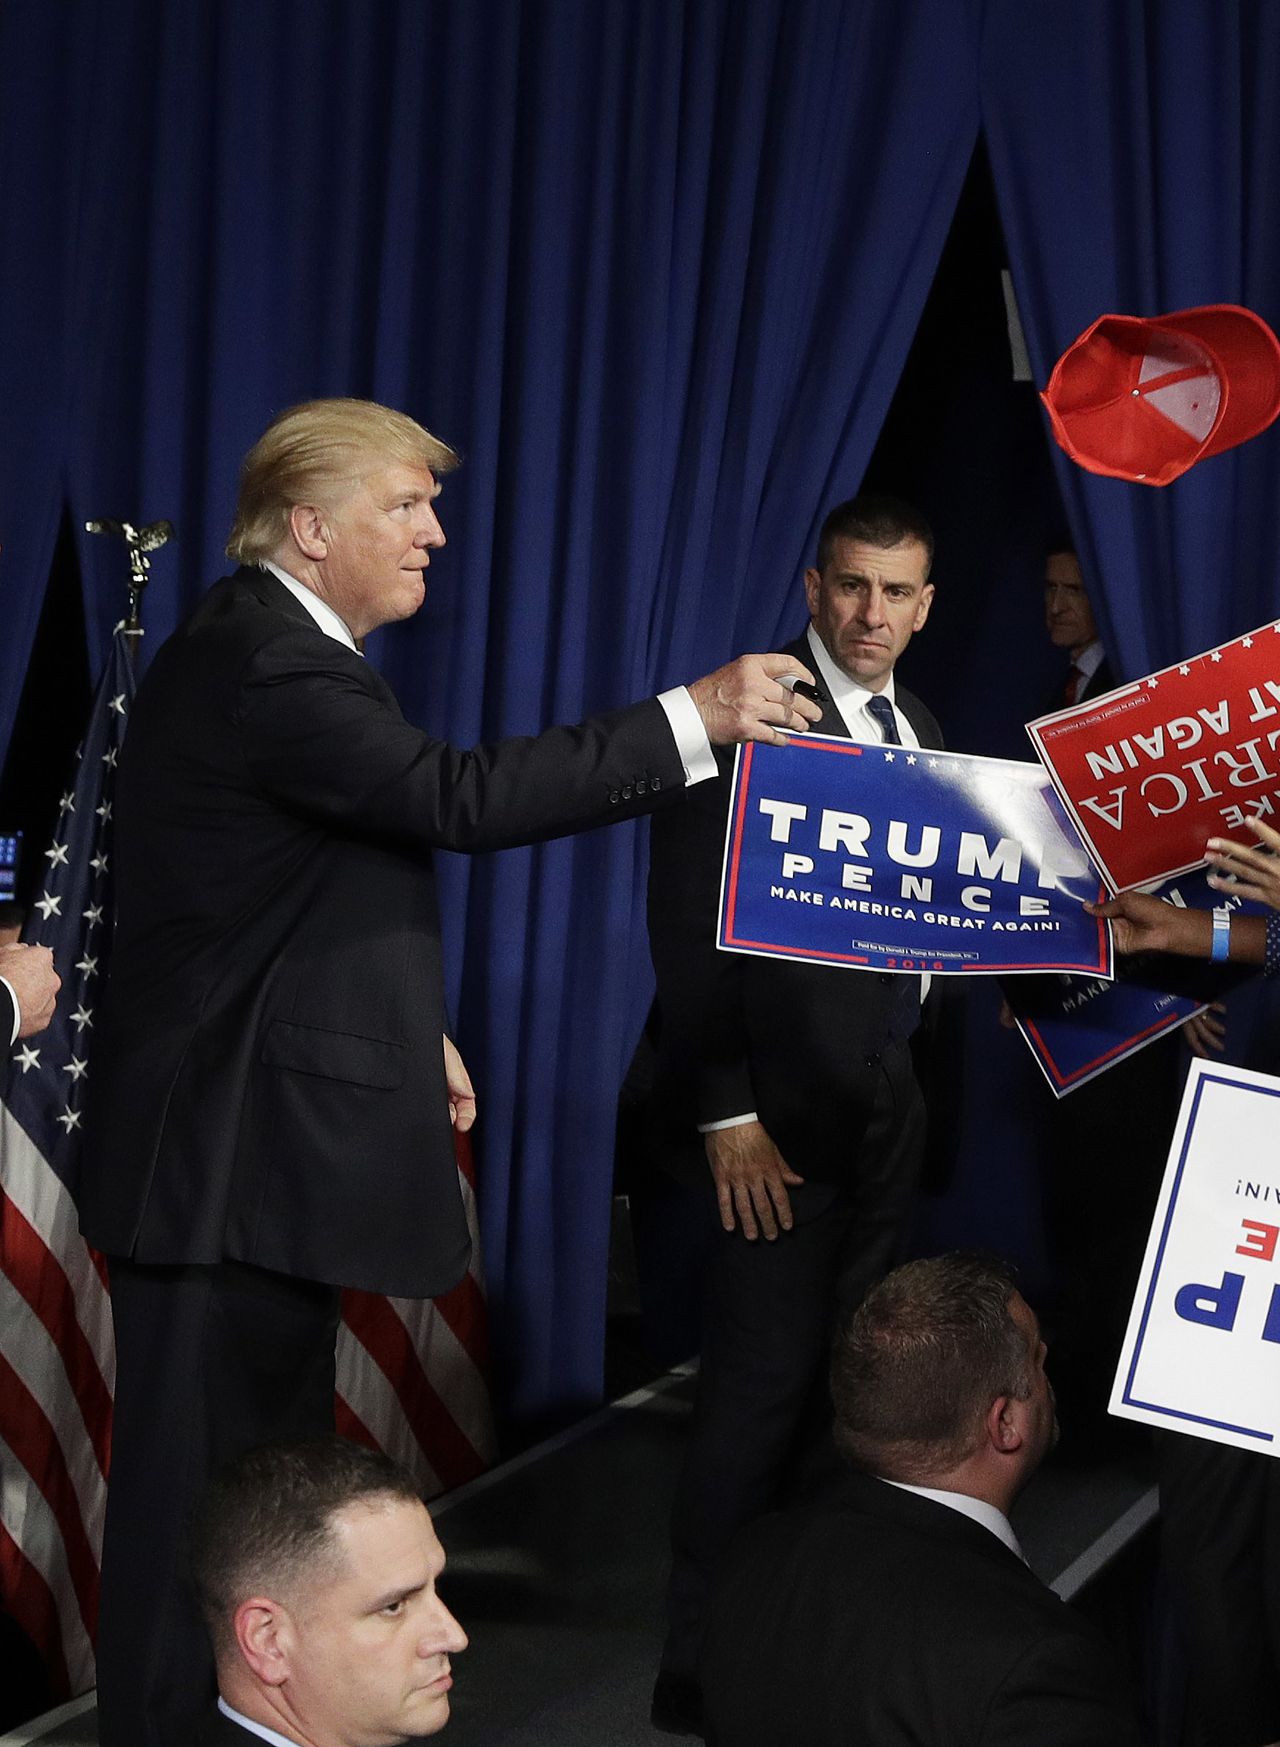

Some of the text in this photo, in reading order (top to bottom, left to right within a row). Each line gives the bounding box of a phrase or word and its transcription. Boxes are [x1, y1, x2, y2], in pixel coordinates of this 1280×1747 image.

[1085, 700, 1231, 781] AGAIN
[759, 798, 1088, 889] TRUMP
[770, 885, 1061, 932] MAKE AMERICA GREAT AGAIN!
[782, 852, 1050, 916] PENCE
[886, 958, 944, 970] 2016
